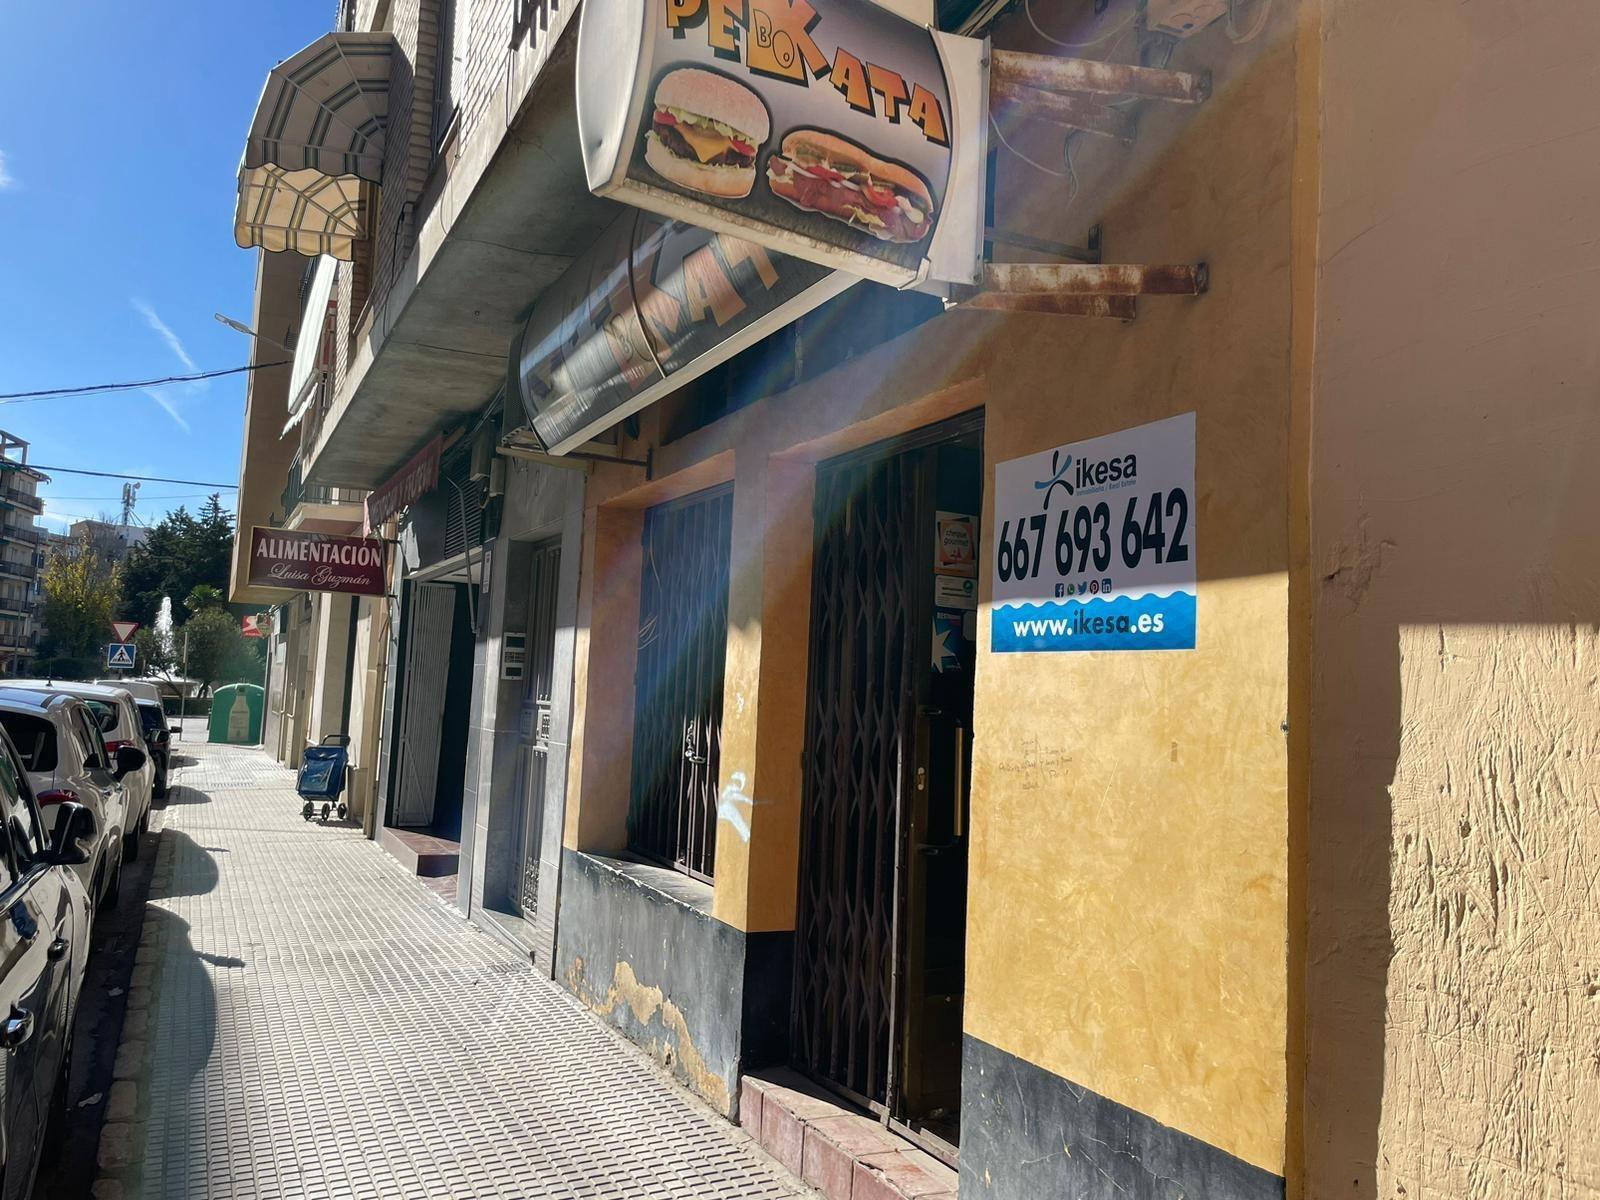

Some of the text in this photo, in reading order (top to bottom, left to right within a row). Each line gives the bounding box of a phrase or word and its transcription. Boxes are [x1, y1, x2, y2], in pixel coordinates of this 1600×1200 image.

[1076, 454, 1137, 488] ikesa
[998, 487, 1189, 583] 667 693 642
[256, 538, 381, 567] ALIMENTACIÓN
[267, 562, 371, 588] Luisa Guzmán
[1013, 609, 1165, 637] www.ikesa.es
